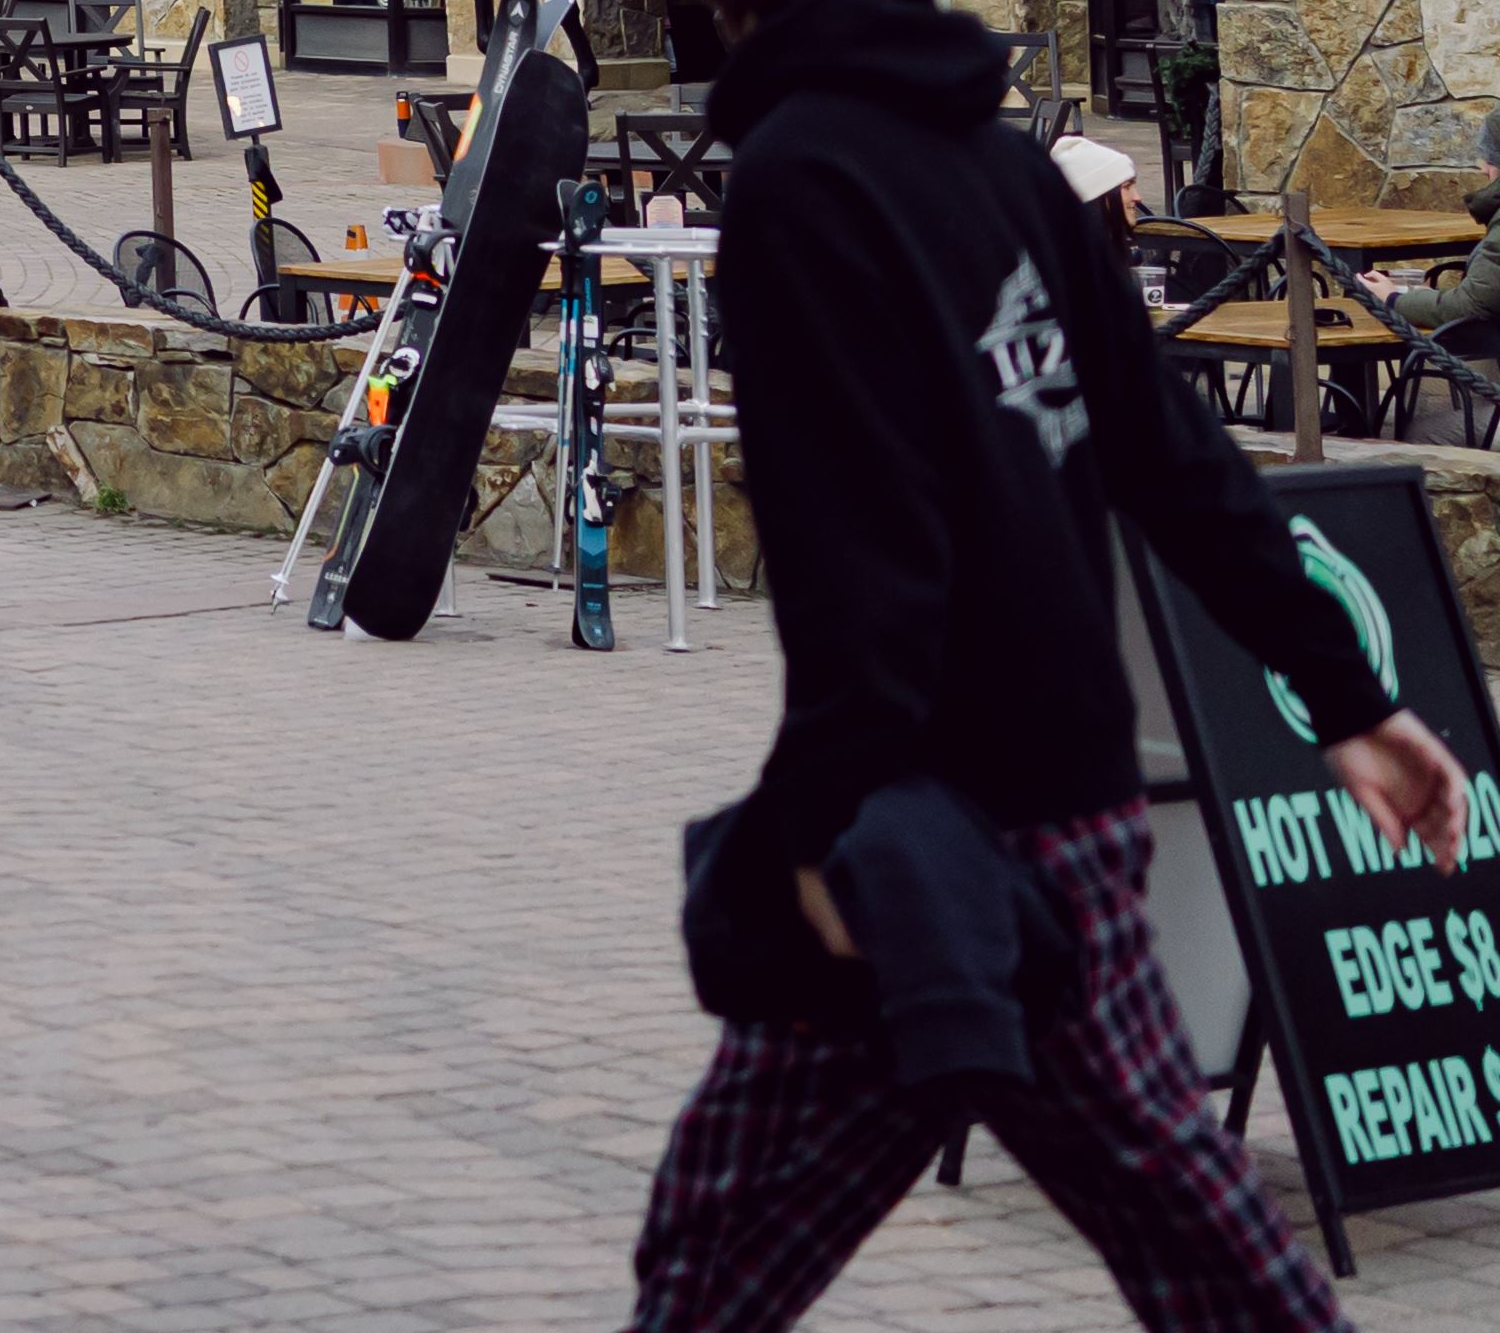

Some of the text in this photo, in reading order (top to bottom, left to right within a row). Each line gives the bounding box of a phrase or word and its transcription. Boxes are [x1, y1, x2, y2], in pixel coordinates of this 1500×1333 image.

[493, 30, 519, 94] DYNASTAR
[1233, 789, 1332, 888] HOT
[1324, 906, 1500, 1018] EDGE $8
[1324, 1055, 1492, 1165] REPAIR
